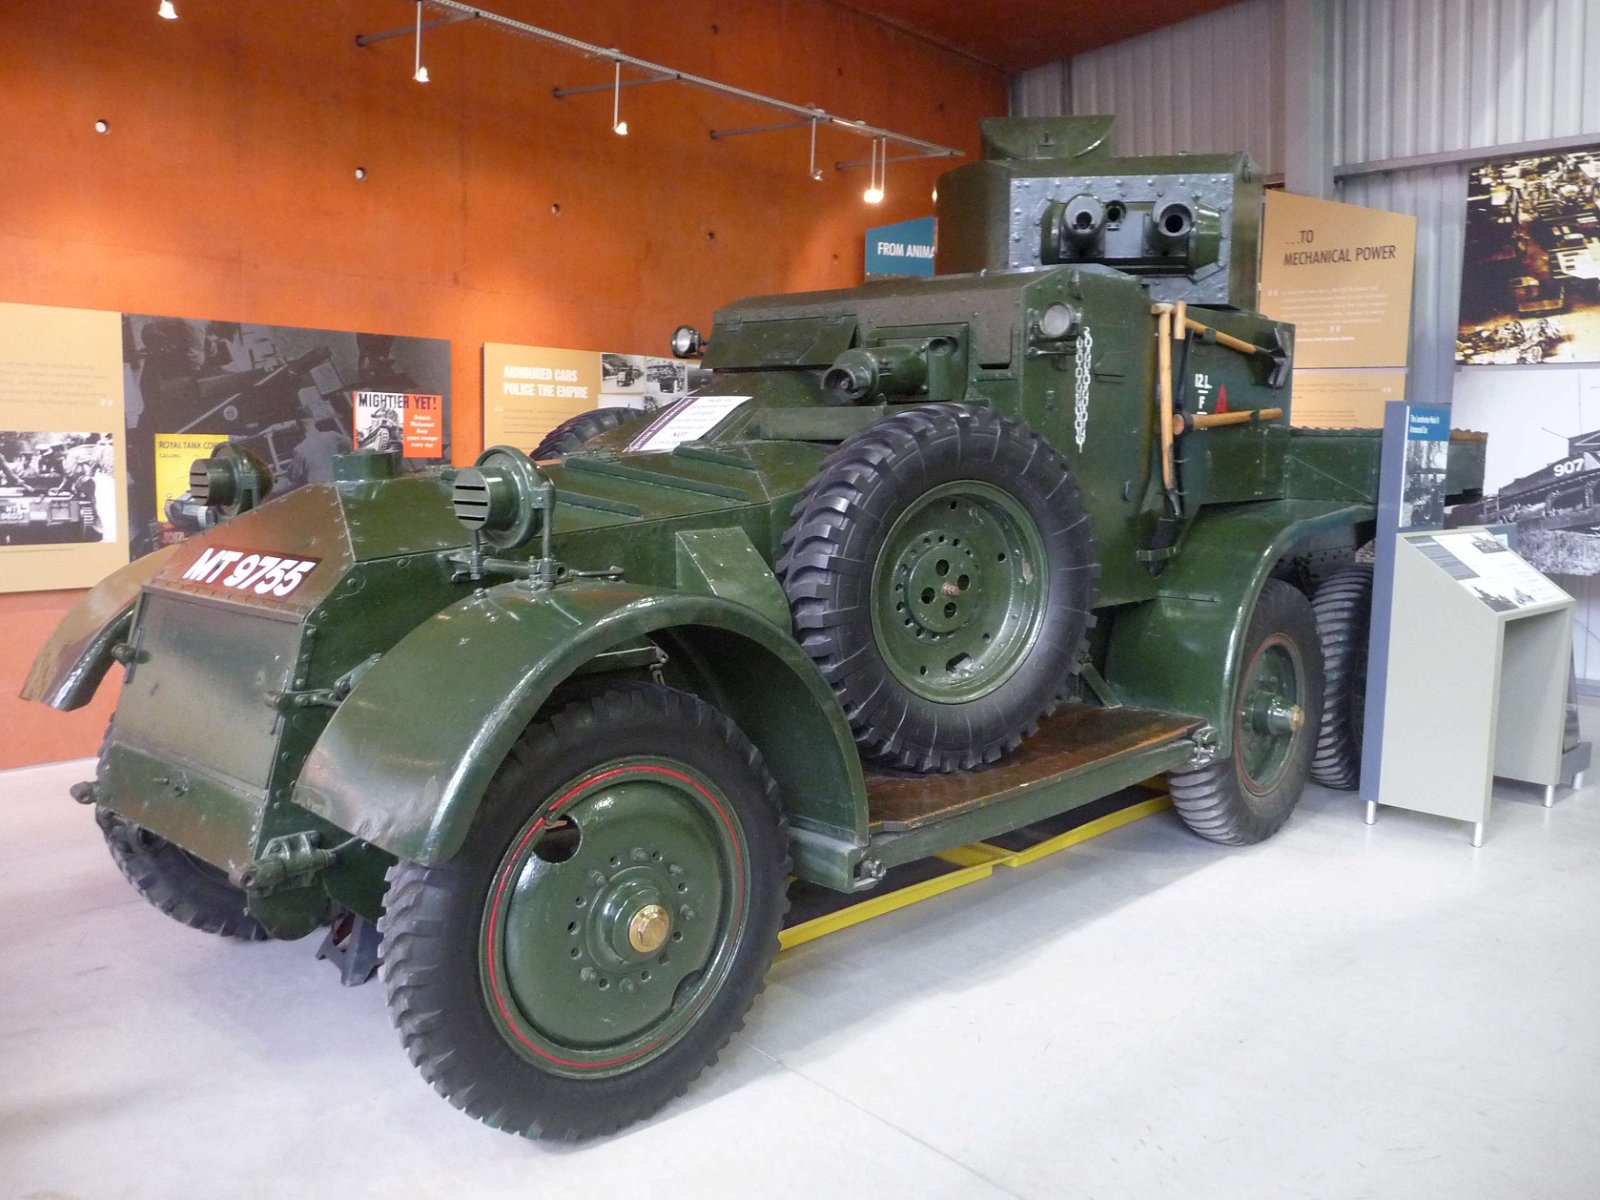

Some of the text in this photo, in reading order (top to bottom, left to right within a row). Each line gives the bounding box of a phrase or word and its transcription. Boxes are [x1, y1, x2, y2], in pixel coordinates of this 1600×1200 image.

[877, 241, 936, 259] FROM ANIMA
[1283, 245, 1396, 266] MECHANICAL POWER
[503, 365, 578, 382] ARMOURED CARS
[503, 382, 589, 399] POLICE THE EMPIRE
[358, 393, 437, 410] MIGHTIER YET!
[159, 441, 181, 449] ROYAL
[1553, 457, 1585, 477] 907
[182, 548, 317, 597] MT 9755
